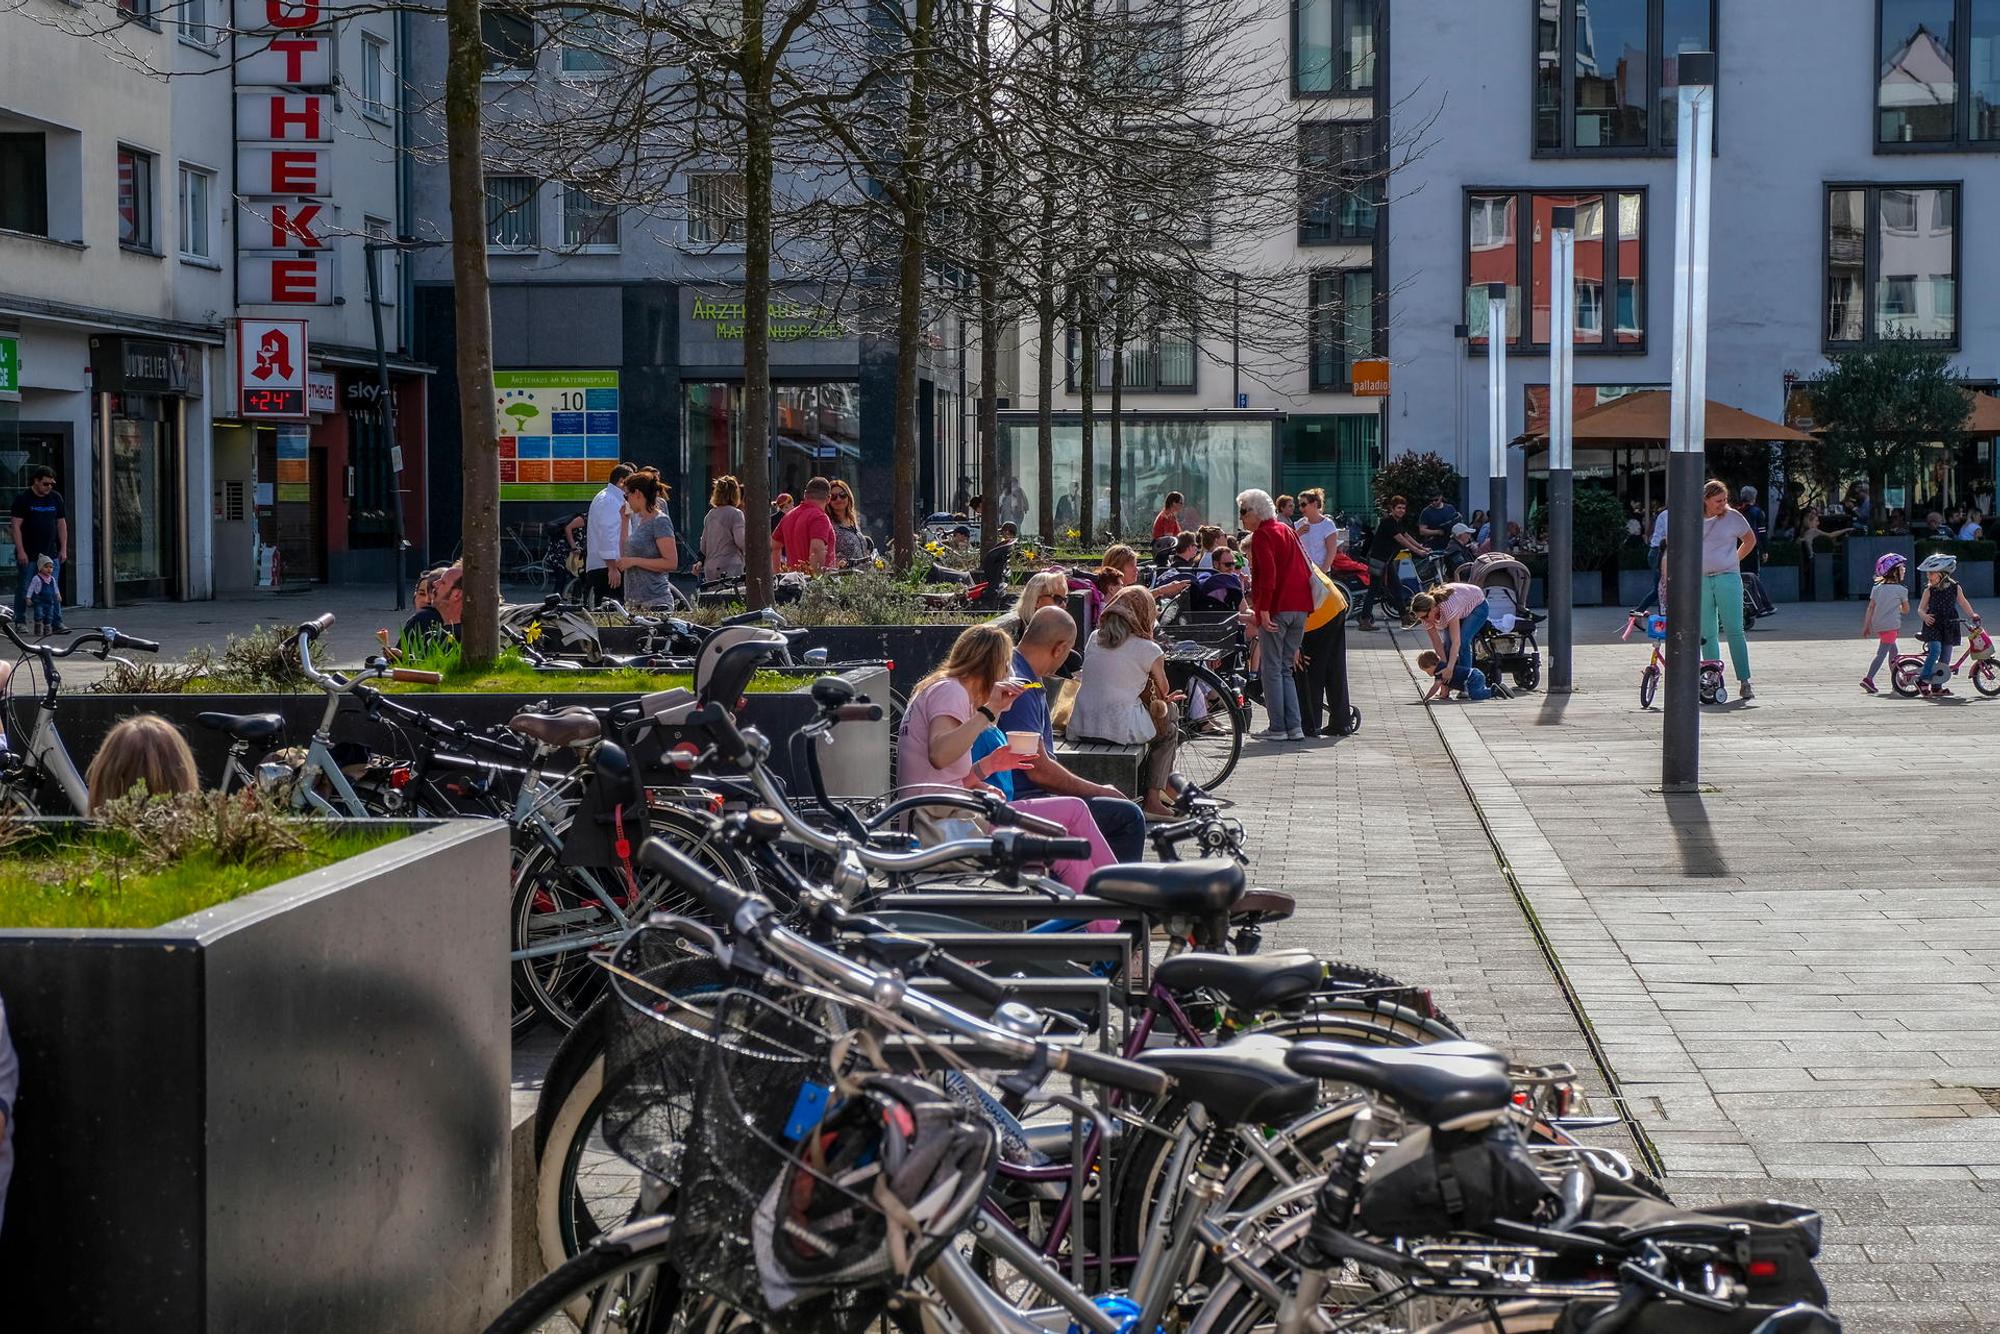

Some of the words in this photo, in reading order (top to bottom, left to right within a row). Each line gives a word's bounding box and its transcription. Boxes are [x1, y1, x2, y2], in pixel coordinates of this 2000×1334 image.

[692, 296, 800, 320] ÄRZTAUS
[716, 322, 844, 339] MATNUSPLATZ
[347, 381, 380, 401] sky
[1353, 379, 1388, 395] palladio
[560, 392, 584, 411] 10
